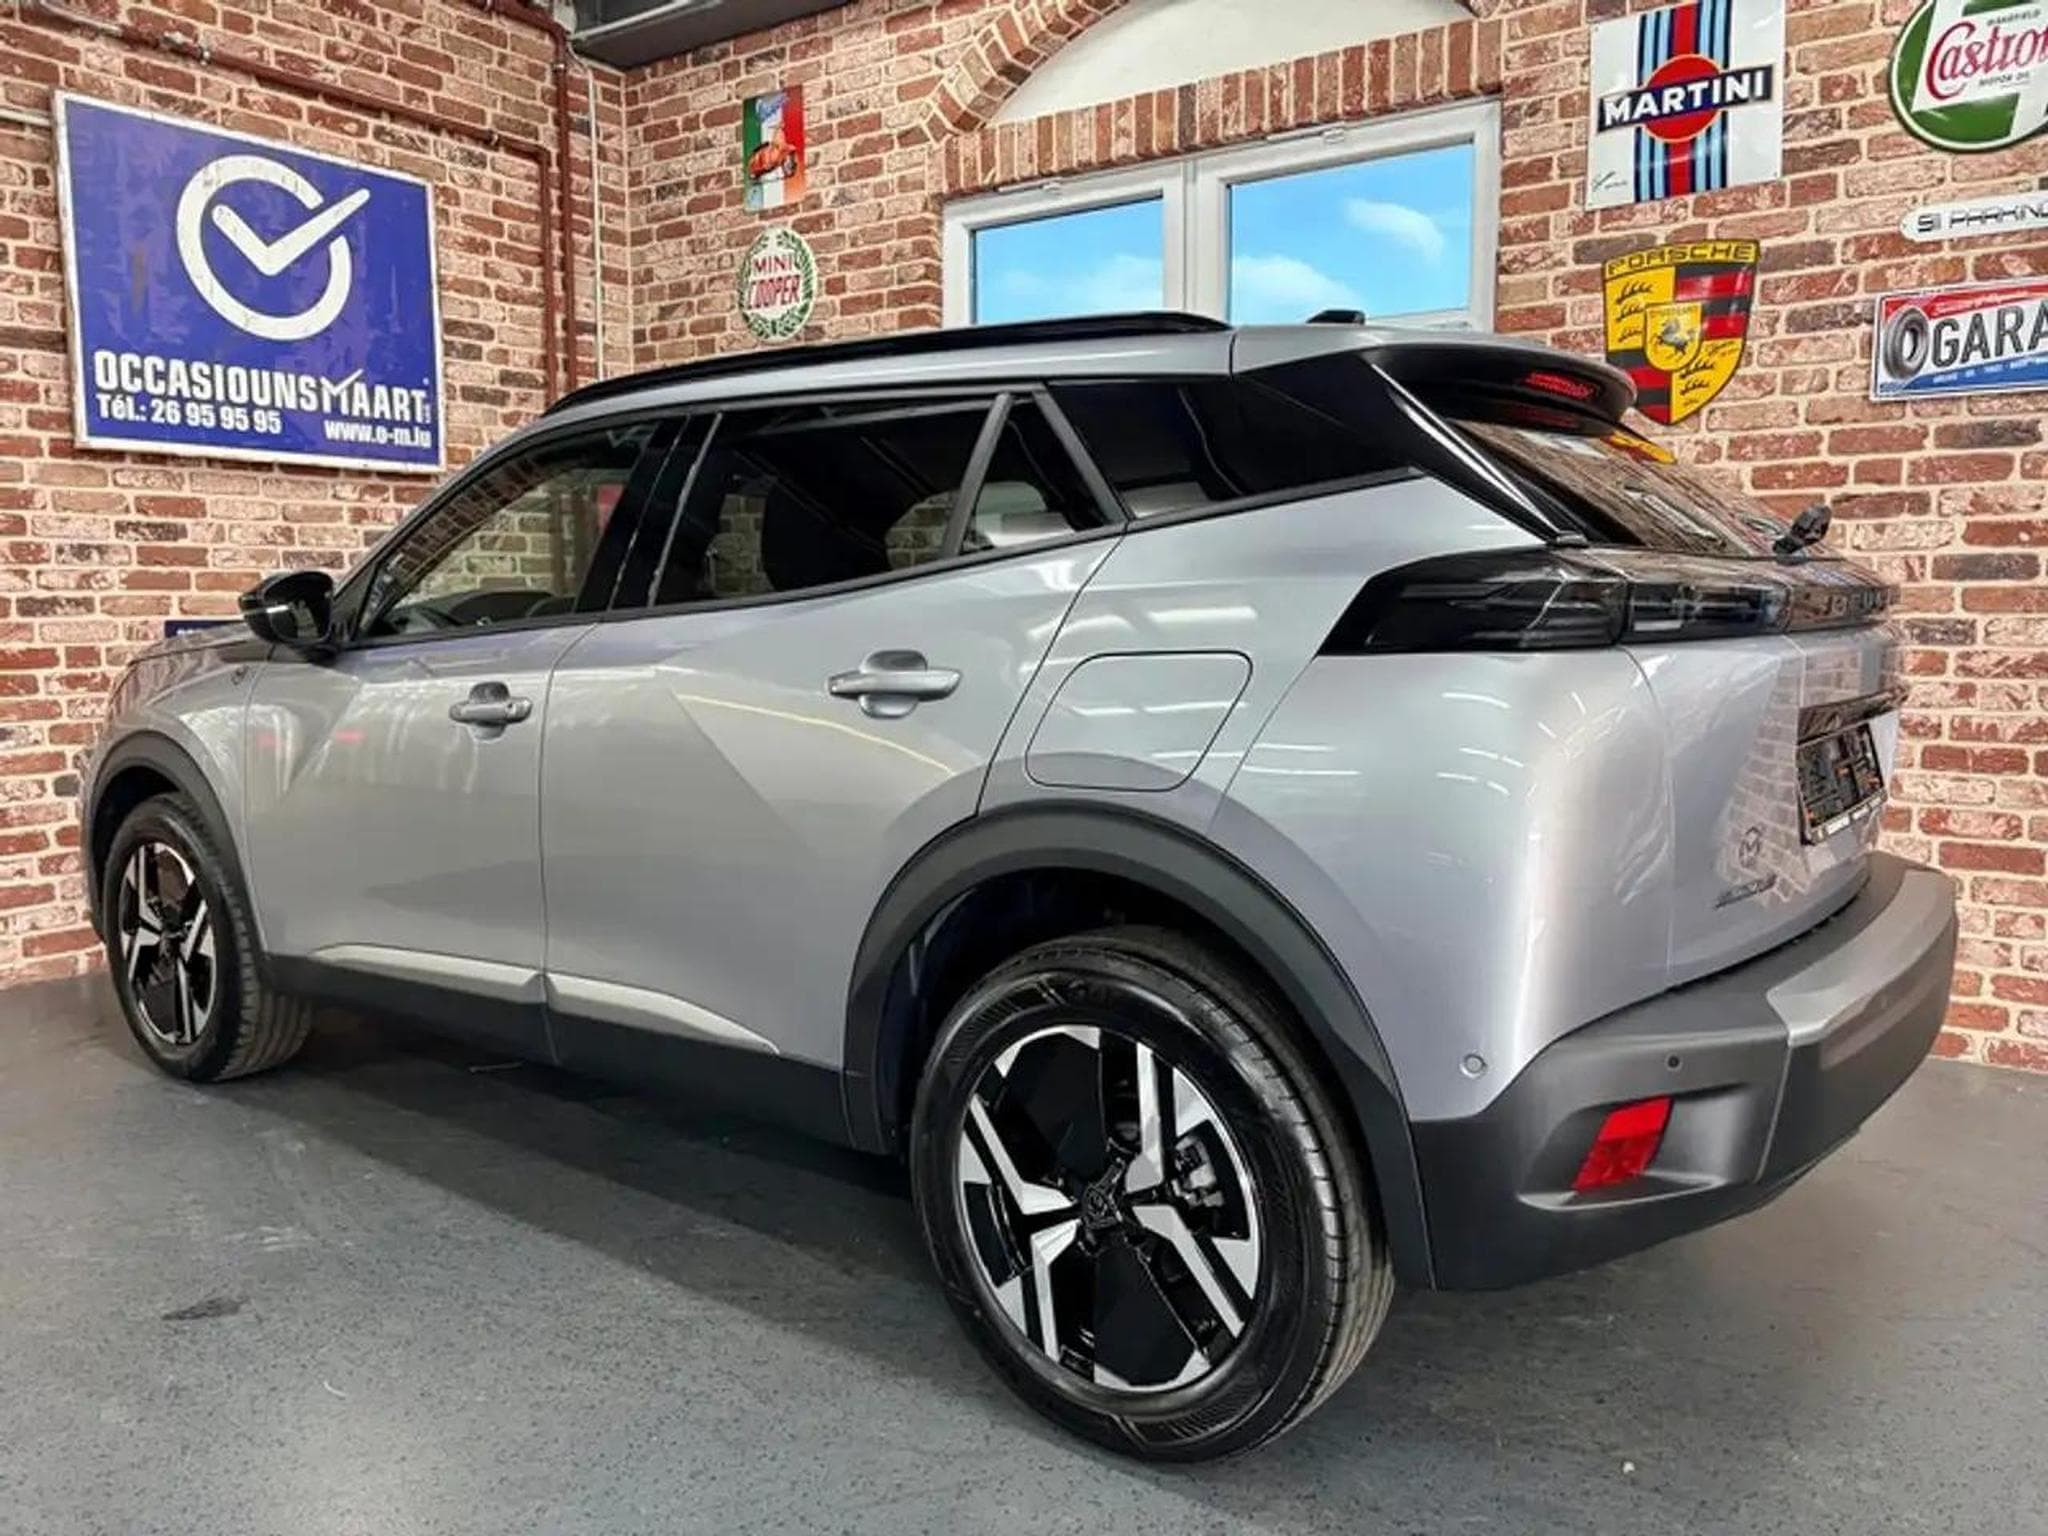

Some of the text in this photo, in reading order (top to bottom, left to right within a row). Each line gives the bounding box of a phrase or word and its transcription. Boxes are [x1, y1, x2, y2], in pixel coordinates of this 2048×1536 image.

[1604, 71, 1765, 126] MARTINI
[753, 253, 793, 277] MINI
[1608, 244, 1754, 275] PORSCHE
[748, 274, 801, 310] COOPER
[94, 350, 427, 424] OCCASIOUNSMAART
[151, 399, 181, 426] 26
[186, 402, 216, 429] 95
[220, 405, 250, 432] 95
[253, 409, 283, 435] 95
